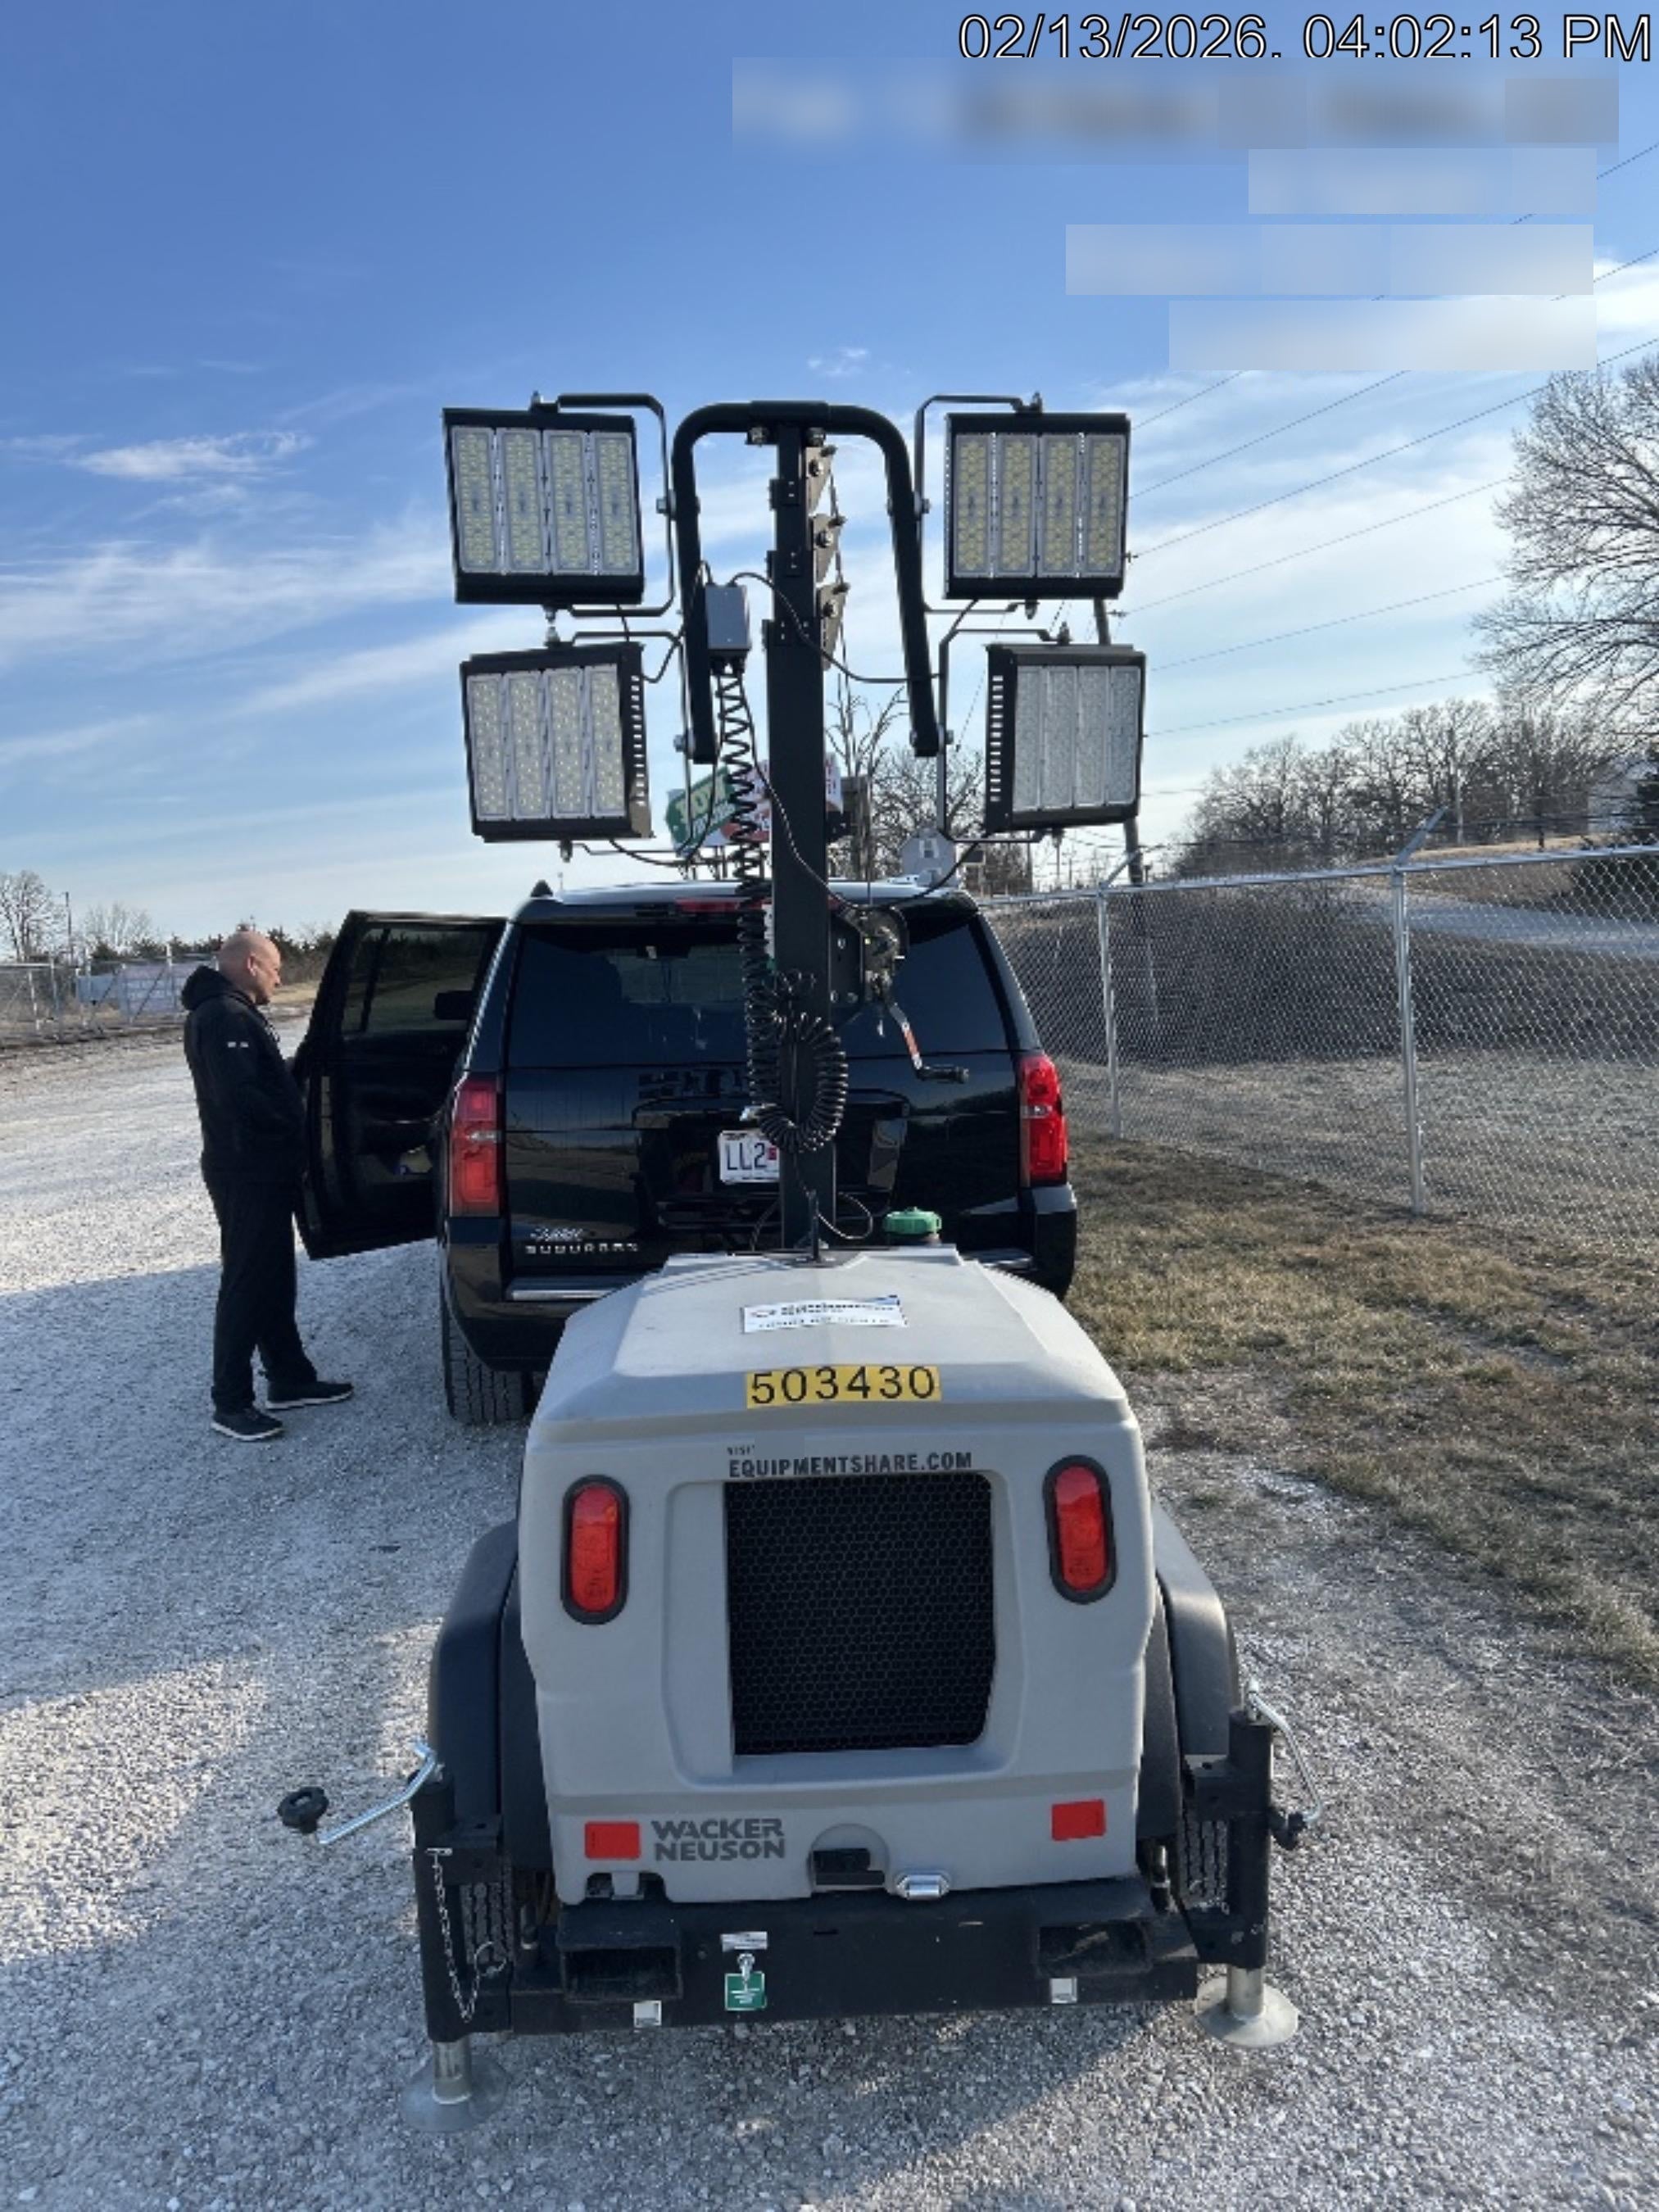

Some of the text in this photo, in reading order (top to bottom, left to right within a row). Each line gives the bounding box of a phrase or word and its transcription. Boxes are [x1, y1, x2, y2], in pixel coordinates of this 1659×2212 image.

[725, 1142, 768, 1171] LL2
[751, 1366, 935, 1404] 503430
[729, 1452, 972, 1478] EQUIPMENTSHARE.COM
[650, 1818, 784, 1841] WACKER
[655, 1838, 786, 1861] NEUSON
